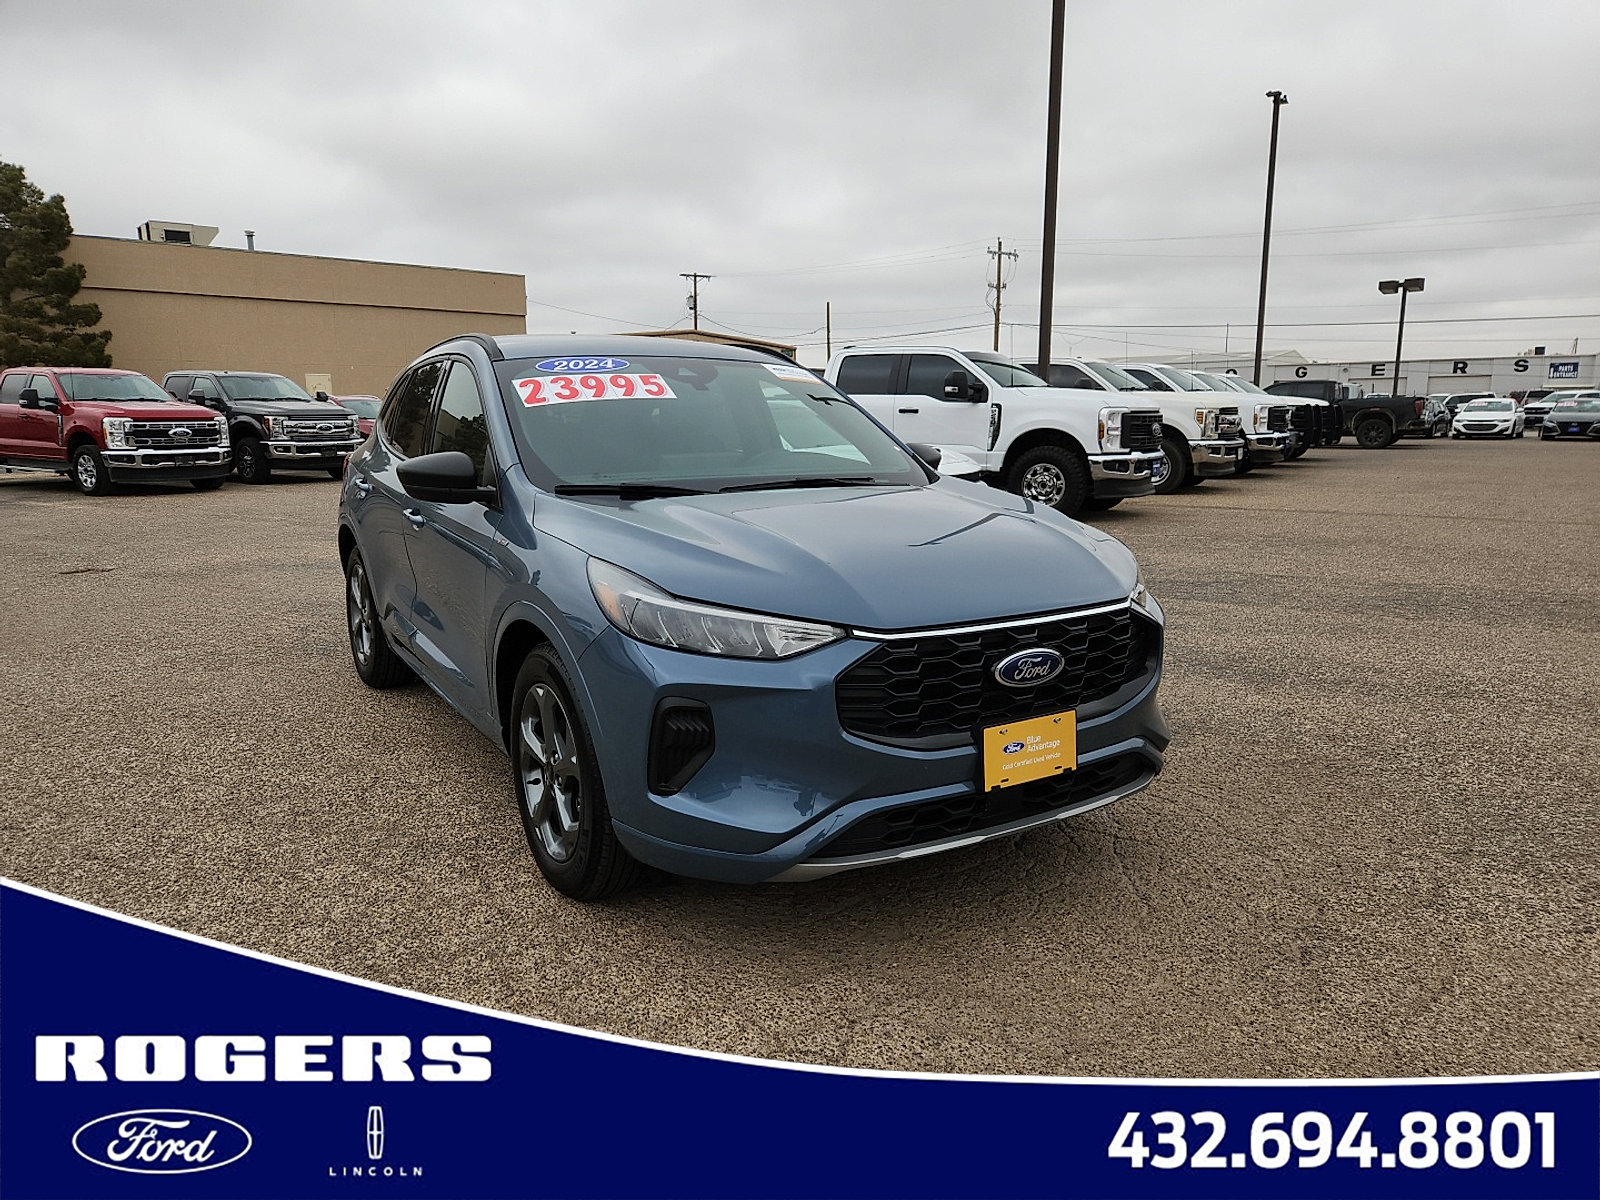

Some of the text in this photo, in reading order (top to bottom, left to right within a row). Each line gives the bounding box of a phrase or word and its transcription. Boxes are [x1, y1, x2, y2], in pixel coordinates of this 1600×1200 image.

[554, 358, 615, 371] 2024
[518, 374, 666, 404] 23995
[1014, 656, 1051, 680] Ford
[1027, 735, 1041, 744] Blue
[1006, 744, 1021, 753] Ford
[1027, 740, 1061, 753] Advantage
[1014, 758, 1033, 767] Certified
[1033, 755, 1045, 763] Used
[1045, 752, 1061, 761] Vehicle
